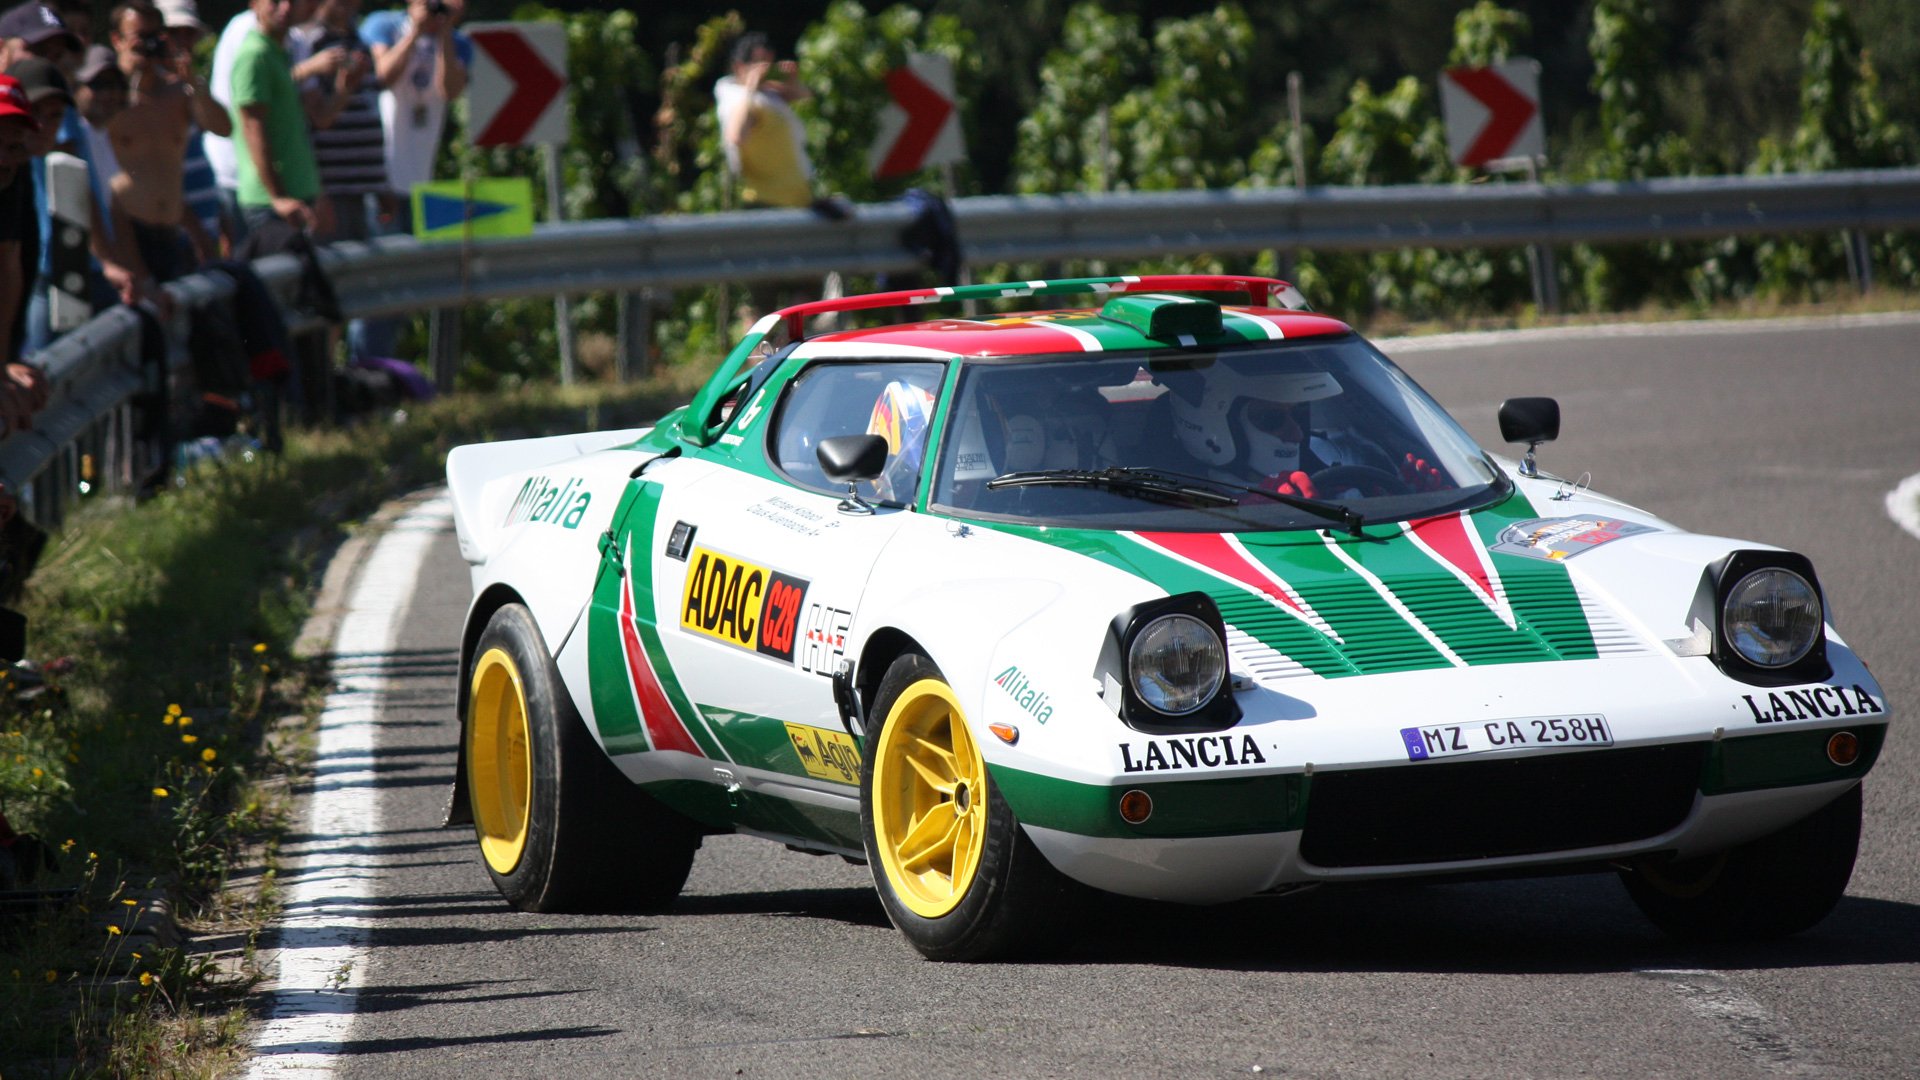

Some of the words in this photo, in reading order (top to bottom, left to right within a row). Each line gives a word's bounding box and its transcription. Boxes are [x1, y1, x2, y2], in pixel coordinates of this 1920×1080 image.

[502, 476, 592, 529] Alitalia
[684, 553, 763, 644] ADAC
[762, 579, 803, 654] C28
[994, 665, 1053, 726] Alitalia
[1741, 683, 1883, 724] LANCIA
[813, 729, 862, 782] Agip
[1119, 734, 1267, 773] LANCIA
[1422, 726, 1469, 753] MZ
[1484, 720, 1527, 745] CA
[1531, 717, 1609, 743] 258H
